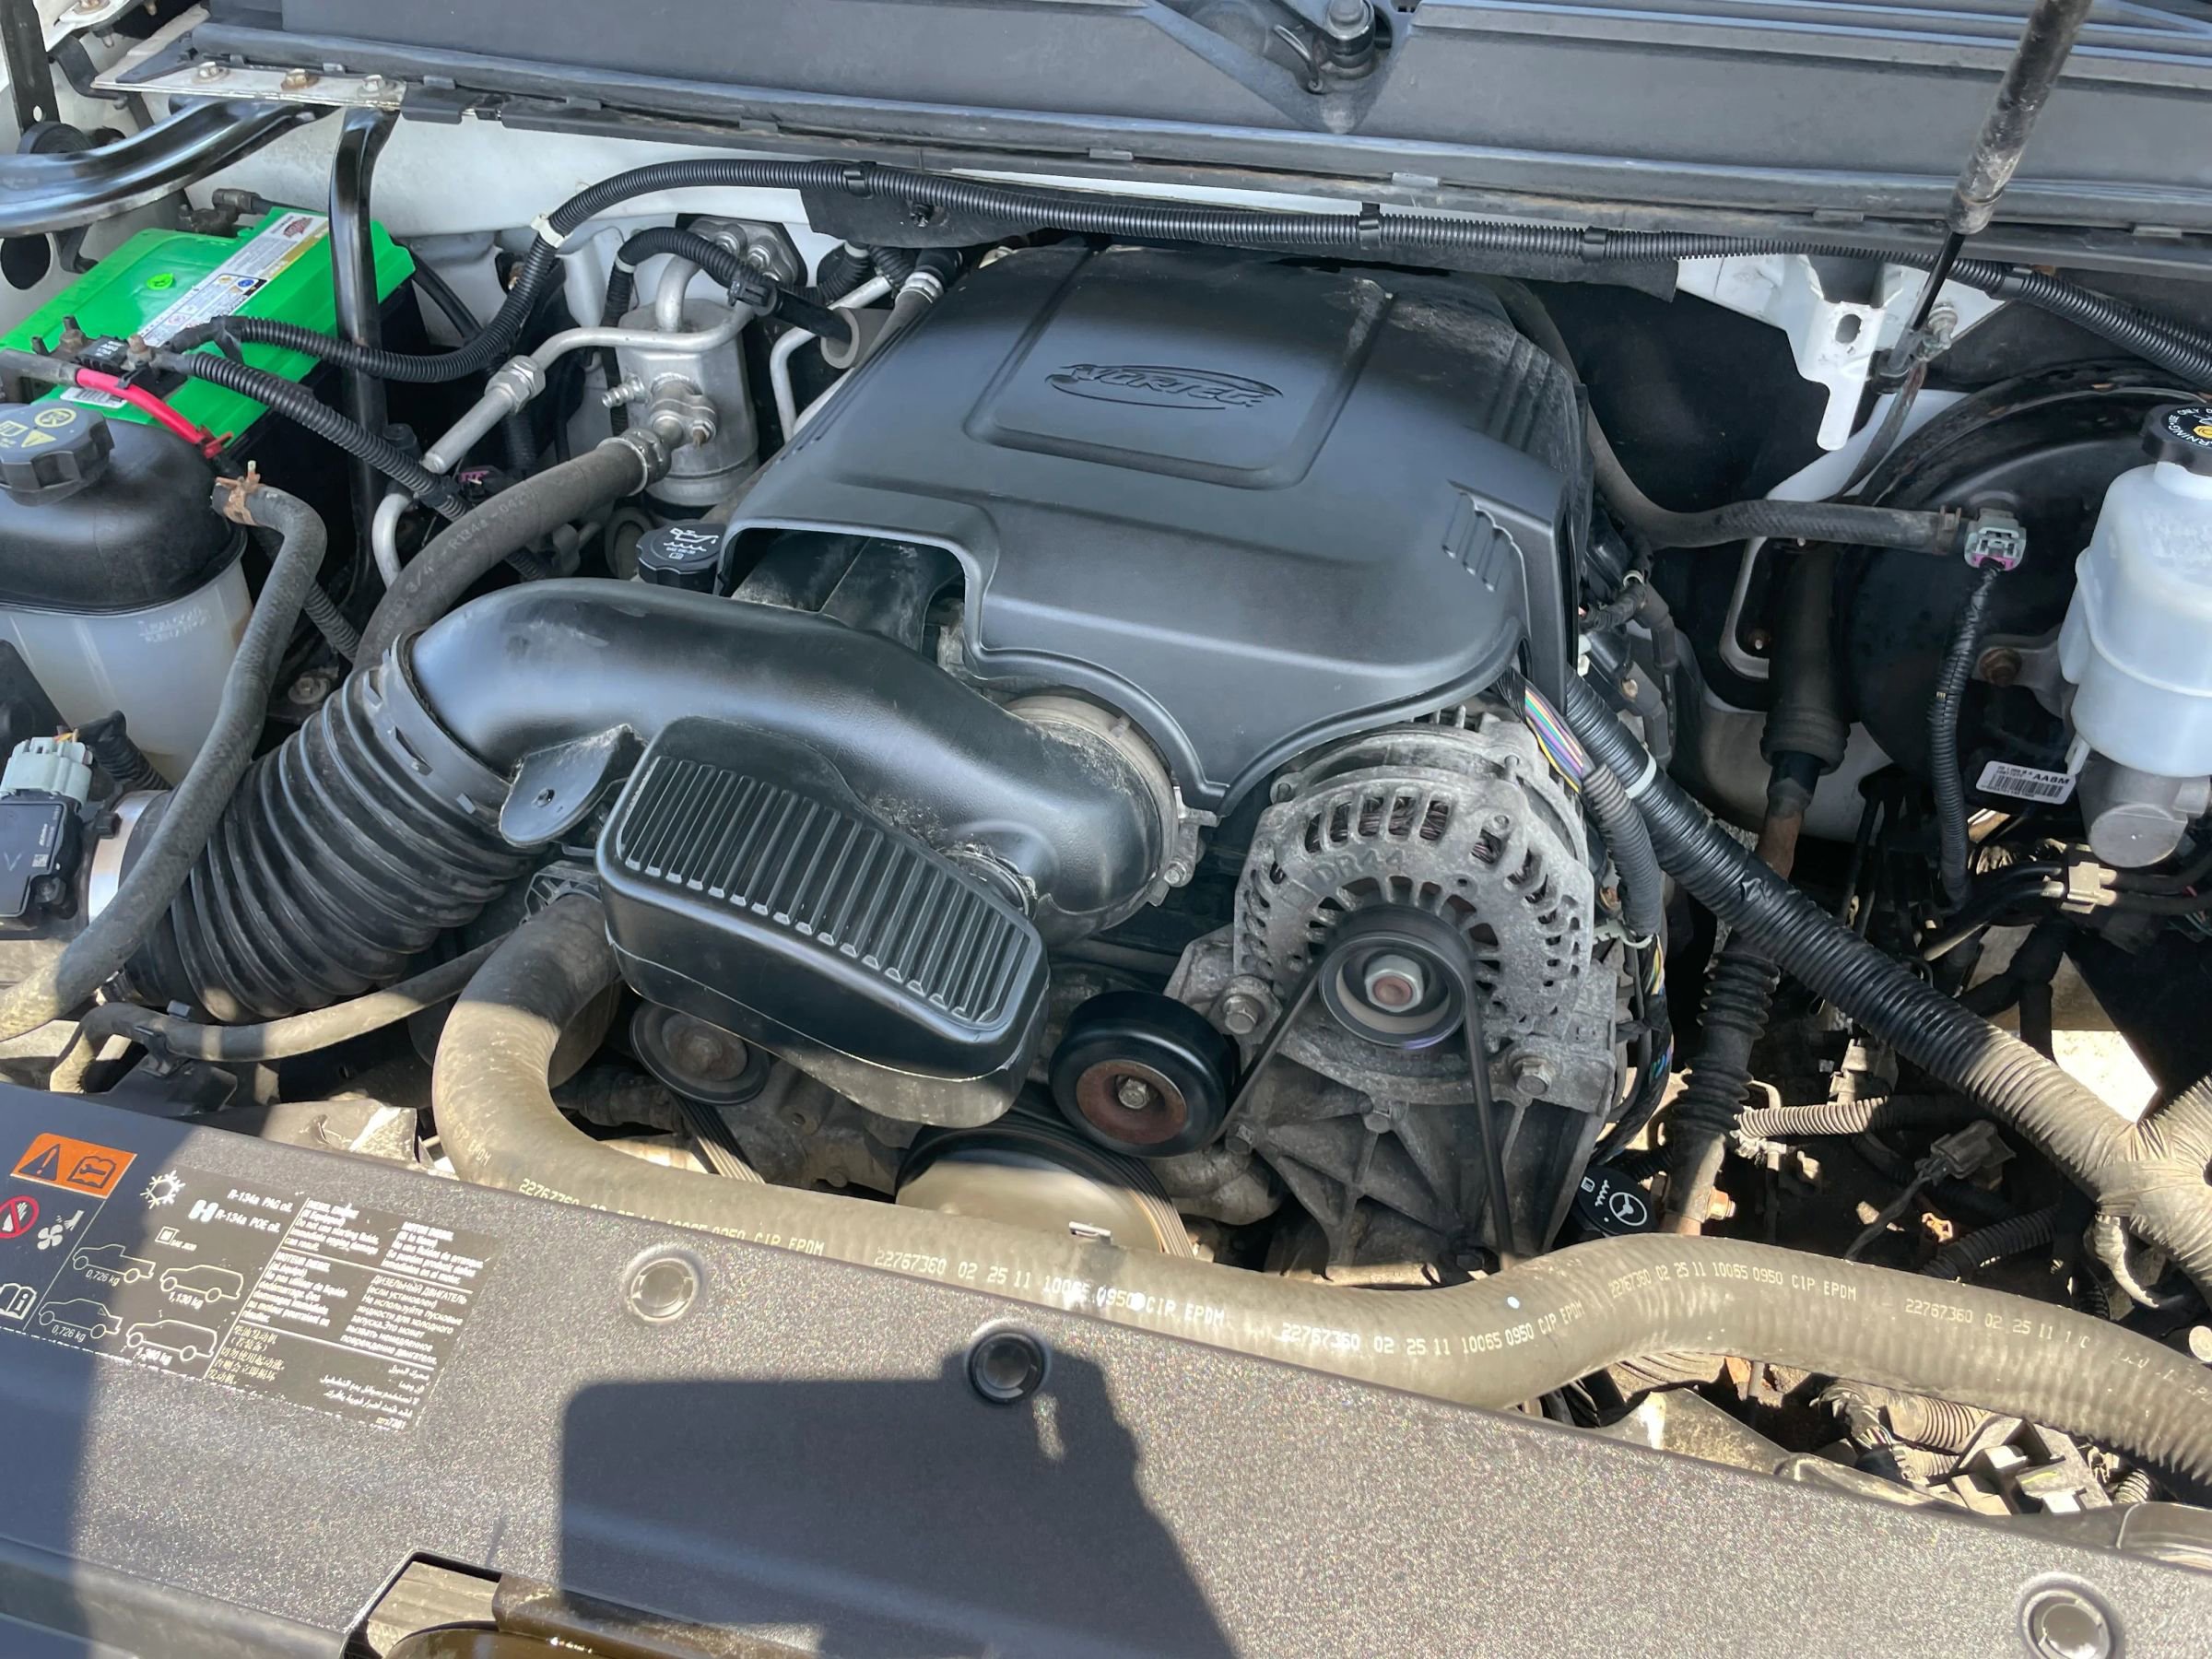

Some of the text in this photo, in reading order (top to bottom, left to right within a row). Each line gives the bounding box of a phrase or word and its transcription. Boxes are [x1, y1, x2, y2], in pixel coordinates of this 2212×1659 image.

[227, 1189, 260, 1206] R-134a
[262, 1197, 282, 1210] PAG
[214, 1209, 247, 1226] R-134a
[249, 1217, 269, 1230] POE
[85, 1269, 121, 1287] 0,726 kg
[874, 1250, 947, 1277] 22767360
[958, 1261, 978, 1280] 02
[986, 1265, 1009, 1285] 25
[1014, 1270, 1031, 1289] 11
[1184, 1302, 1226, 1326] EPDM
[1655, 1265, 1671, 1281] 02
[1674, 1262, 1689, 1278] 25
[1691, 1261, 1707, 1277] 11
[1712, 1262, 1748, 1280] 10065
[1752, 1266, 1783, 1285] 0950
[1823, 1280, 1857, 1301] EPDM
[361, 1293, 374, 1304] Не
[366, 1284, 389, 1296] (если
[371, 1275, 466, 1304] ДИЗЕЛЬНЫЙ ДВИГАТЕЛЬ
[192, 1297, 205, 1310] kg
[1904, 1298, 1973, 1324] 22767360
[1984, 1312, 2003, 1329] 02
[2012, 1318, 2031, 1335] 25
[52, 1324, 87, 1342] 0,726 kg
[1280, 1322, 1360, 1351] 22767360
[1373, 1335, 1394, 1355] 02
[1406, 1337, 1427, 1356] 25
[1433, 1337, 1451, 1356] 11
[1461, 1331, 1502, 1354] 10065
[1504, 1323, 1535, 1347] 0950
[1559, 1300, 1585, 1325] EPDM
[159, 1352, 173, 1366] kg
